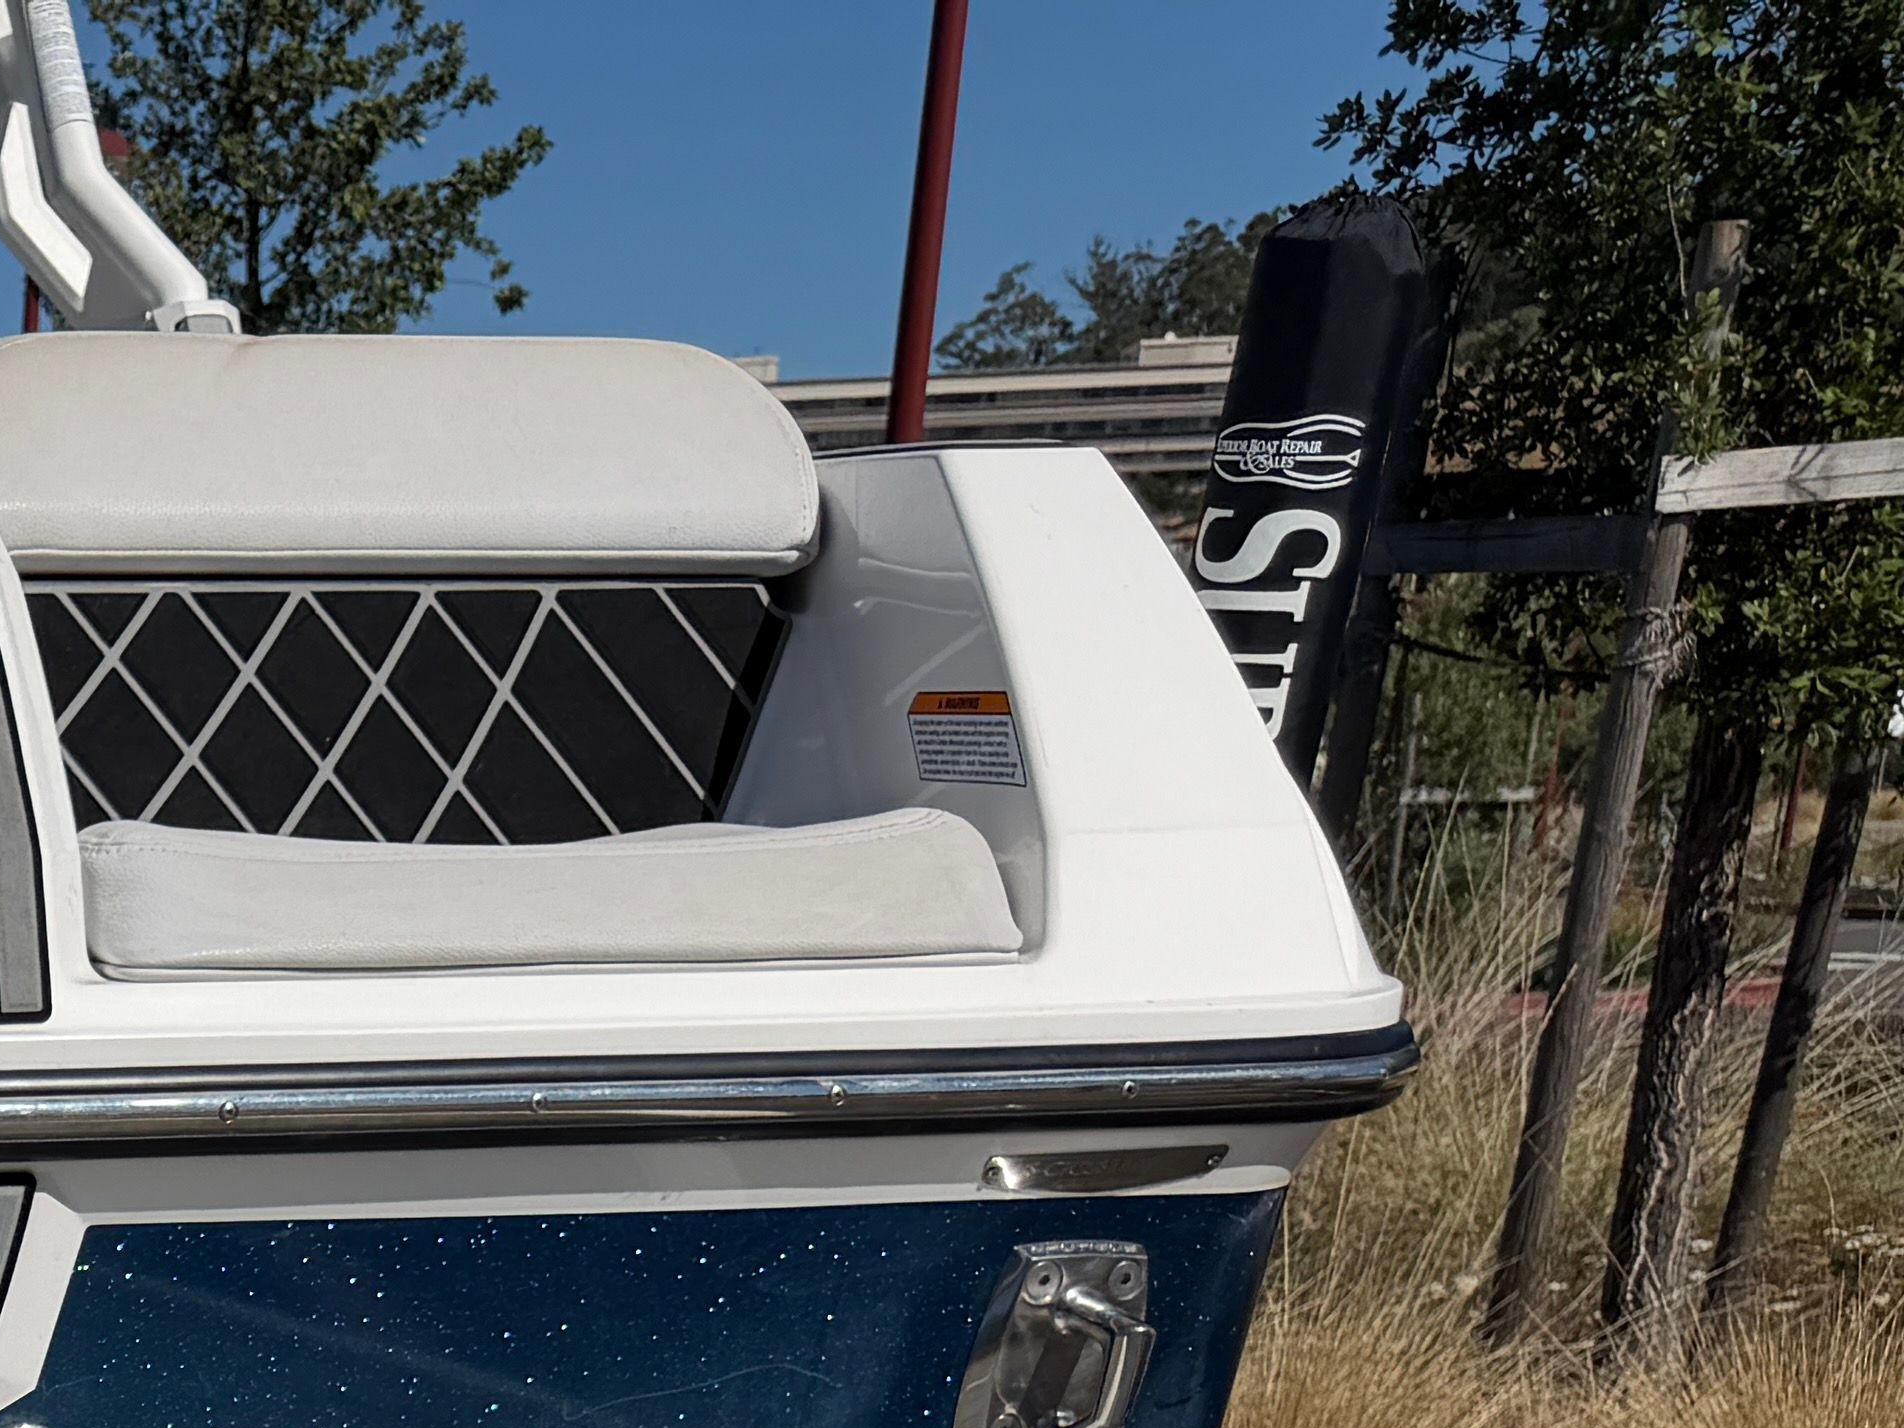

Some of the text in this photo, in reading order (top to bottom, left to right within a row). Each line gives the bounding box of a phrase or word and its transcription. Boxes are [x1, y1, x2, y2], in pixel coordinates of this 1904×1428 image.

[1249, 439, 1280, 453] BOAT
[1280, 439, 1322, 454] REPAIR
[1259, 454, 1295, 469] SALES
